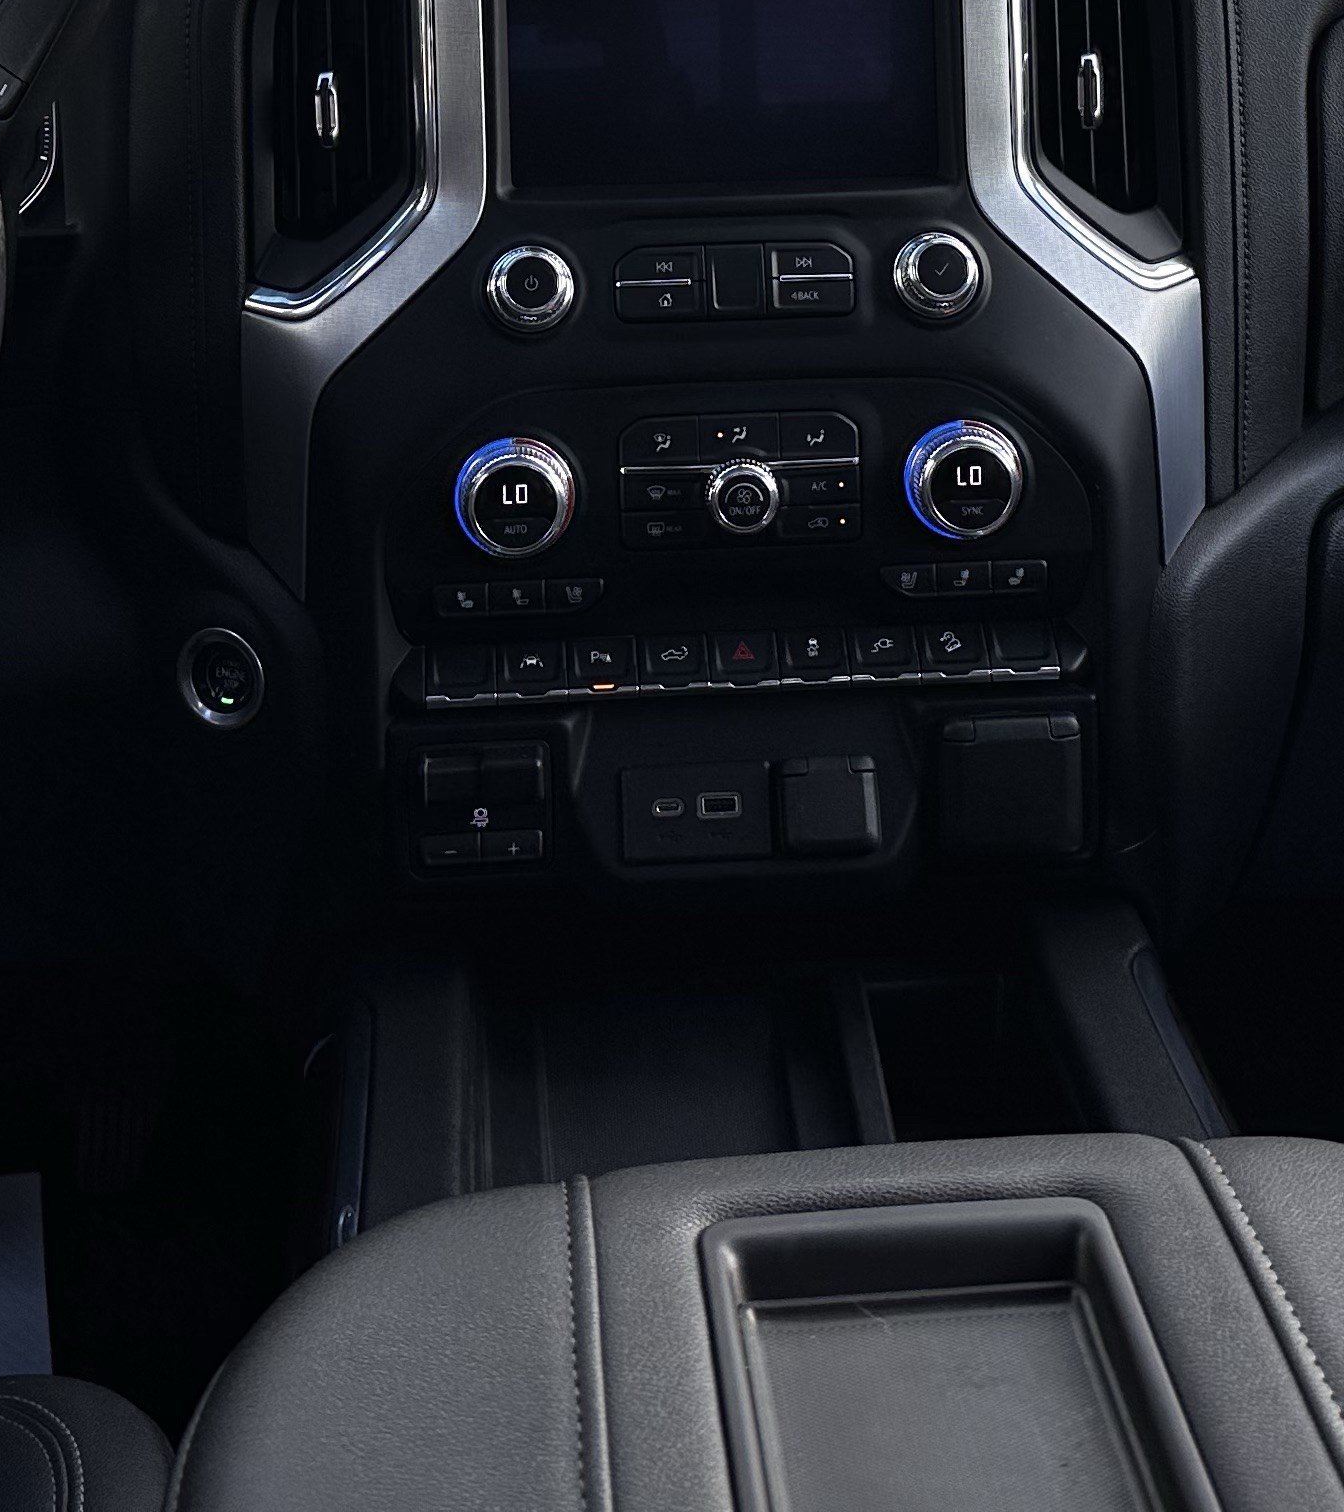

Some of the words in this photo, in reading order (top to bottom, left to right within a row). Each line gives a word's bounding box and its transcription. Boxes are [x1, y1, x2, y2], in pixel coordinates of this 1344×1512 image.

[798, 291, 820, 301] BACK
[956, 465, 982, 486] LO
[811, 481, 827, 491] A/C
[502, 483, 528, 505] LO
[729, 506, 762, 516] ON/OFF
[961, 505, 984, 517] SYNC
[504, 524, 528, 535] AUTO
